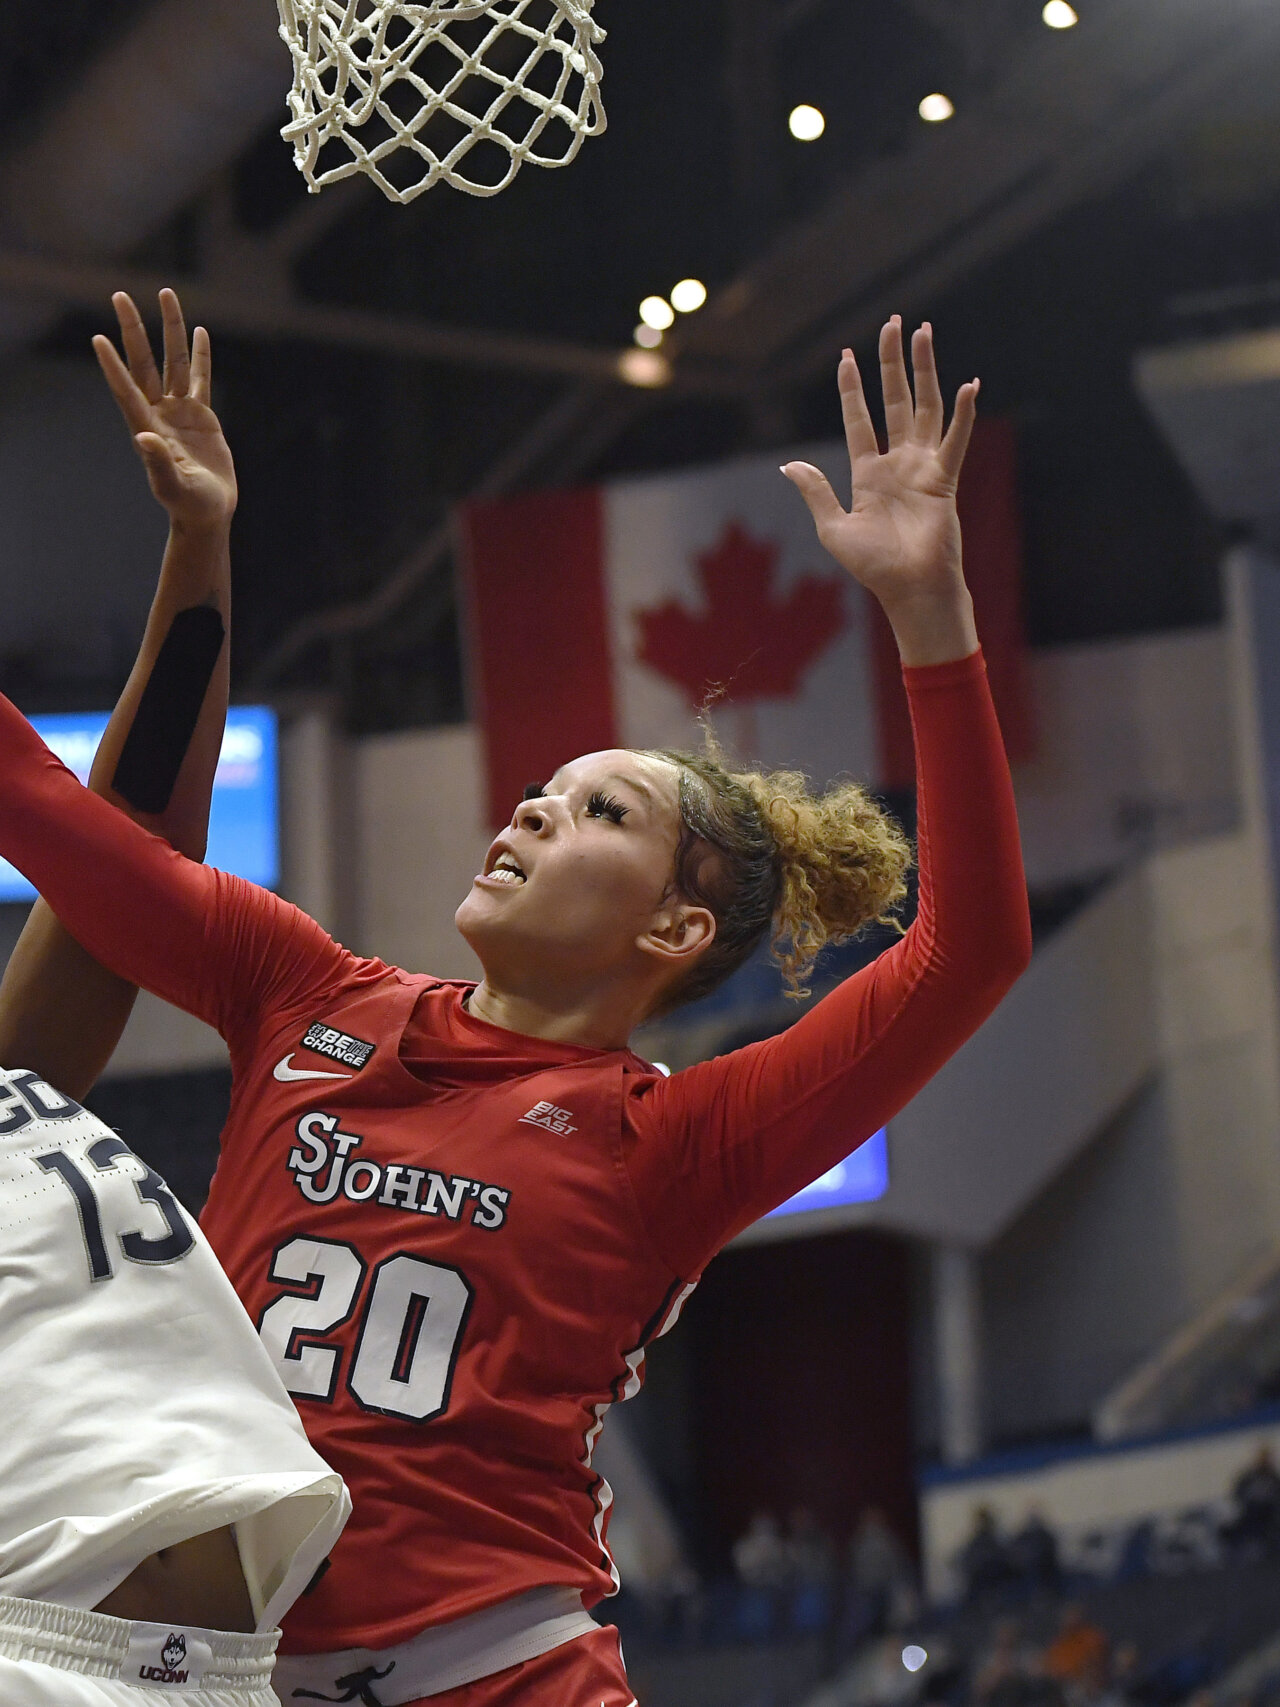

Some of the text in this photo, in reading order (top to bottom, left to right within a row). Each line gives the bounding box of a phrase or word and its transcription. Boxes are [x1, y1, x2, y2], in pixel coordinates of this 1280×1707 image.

[303, 1036, 366, 1067] CHANGE
[524, 1110, 578, 1135] EAST
[533, 1101, 573, 1121] BIG
[30, 1135, 197, 1283] 13
[259, 1233, 475, 1424] 20
[139, 1665, 189, 1683] UCONN
